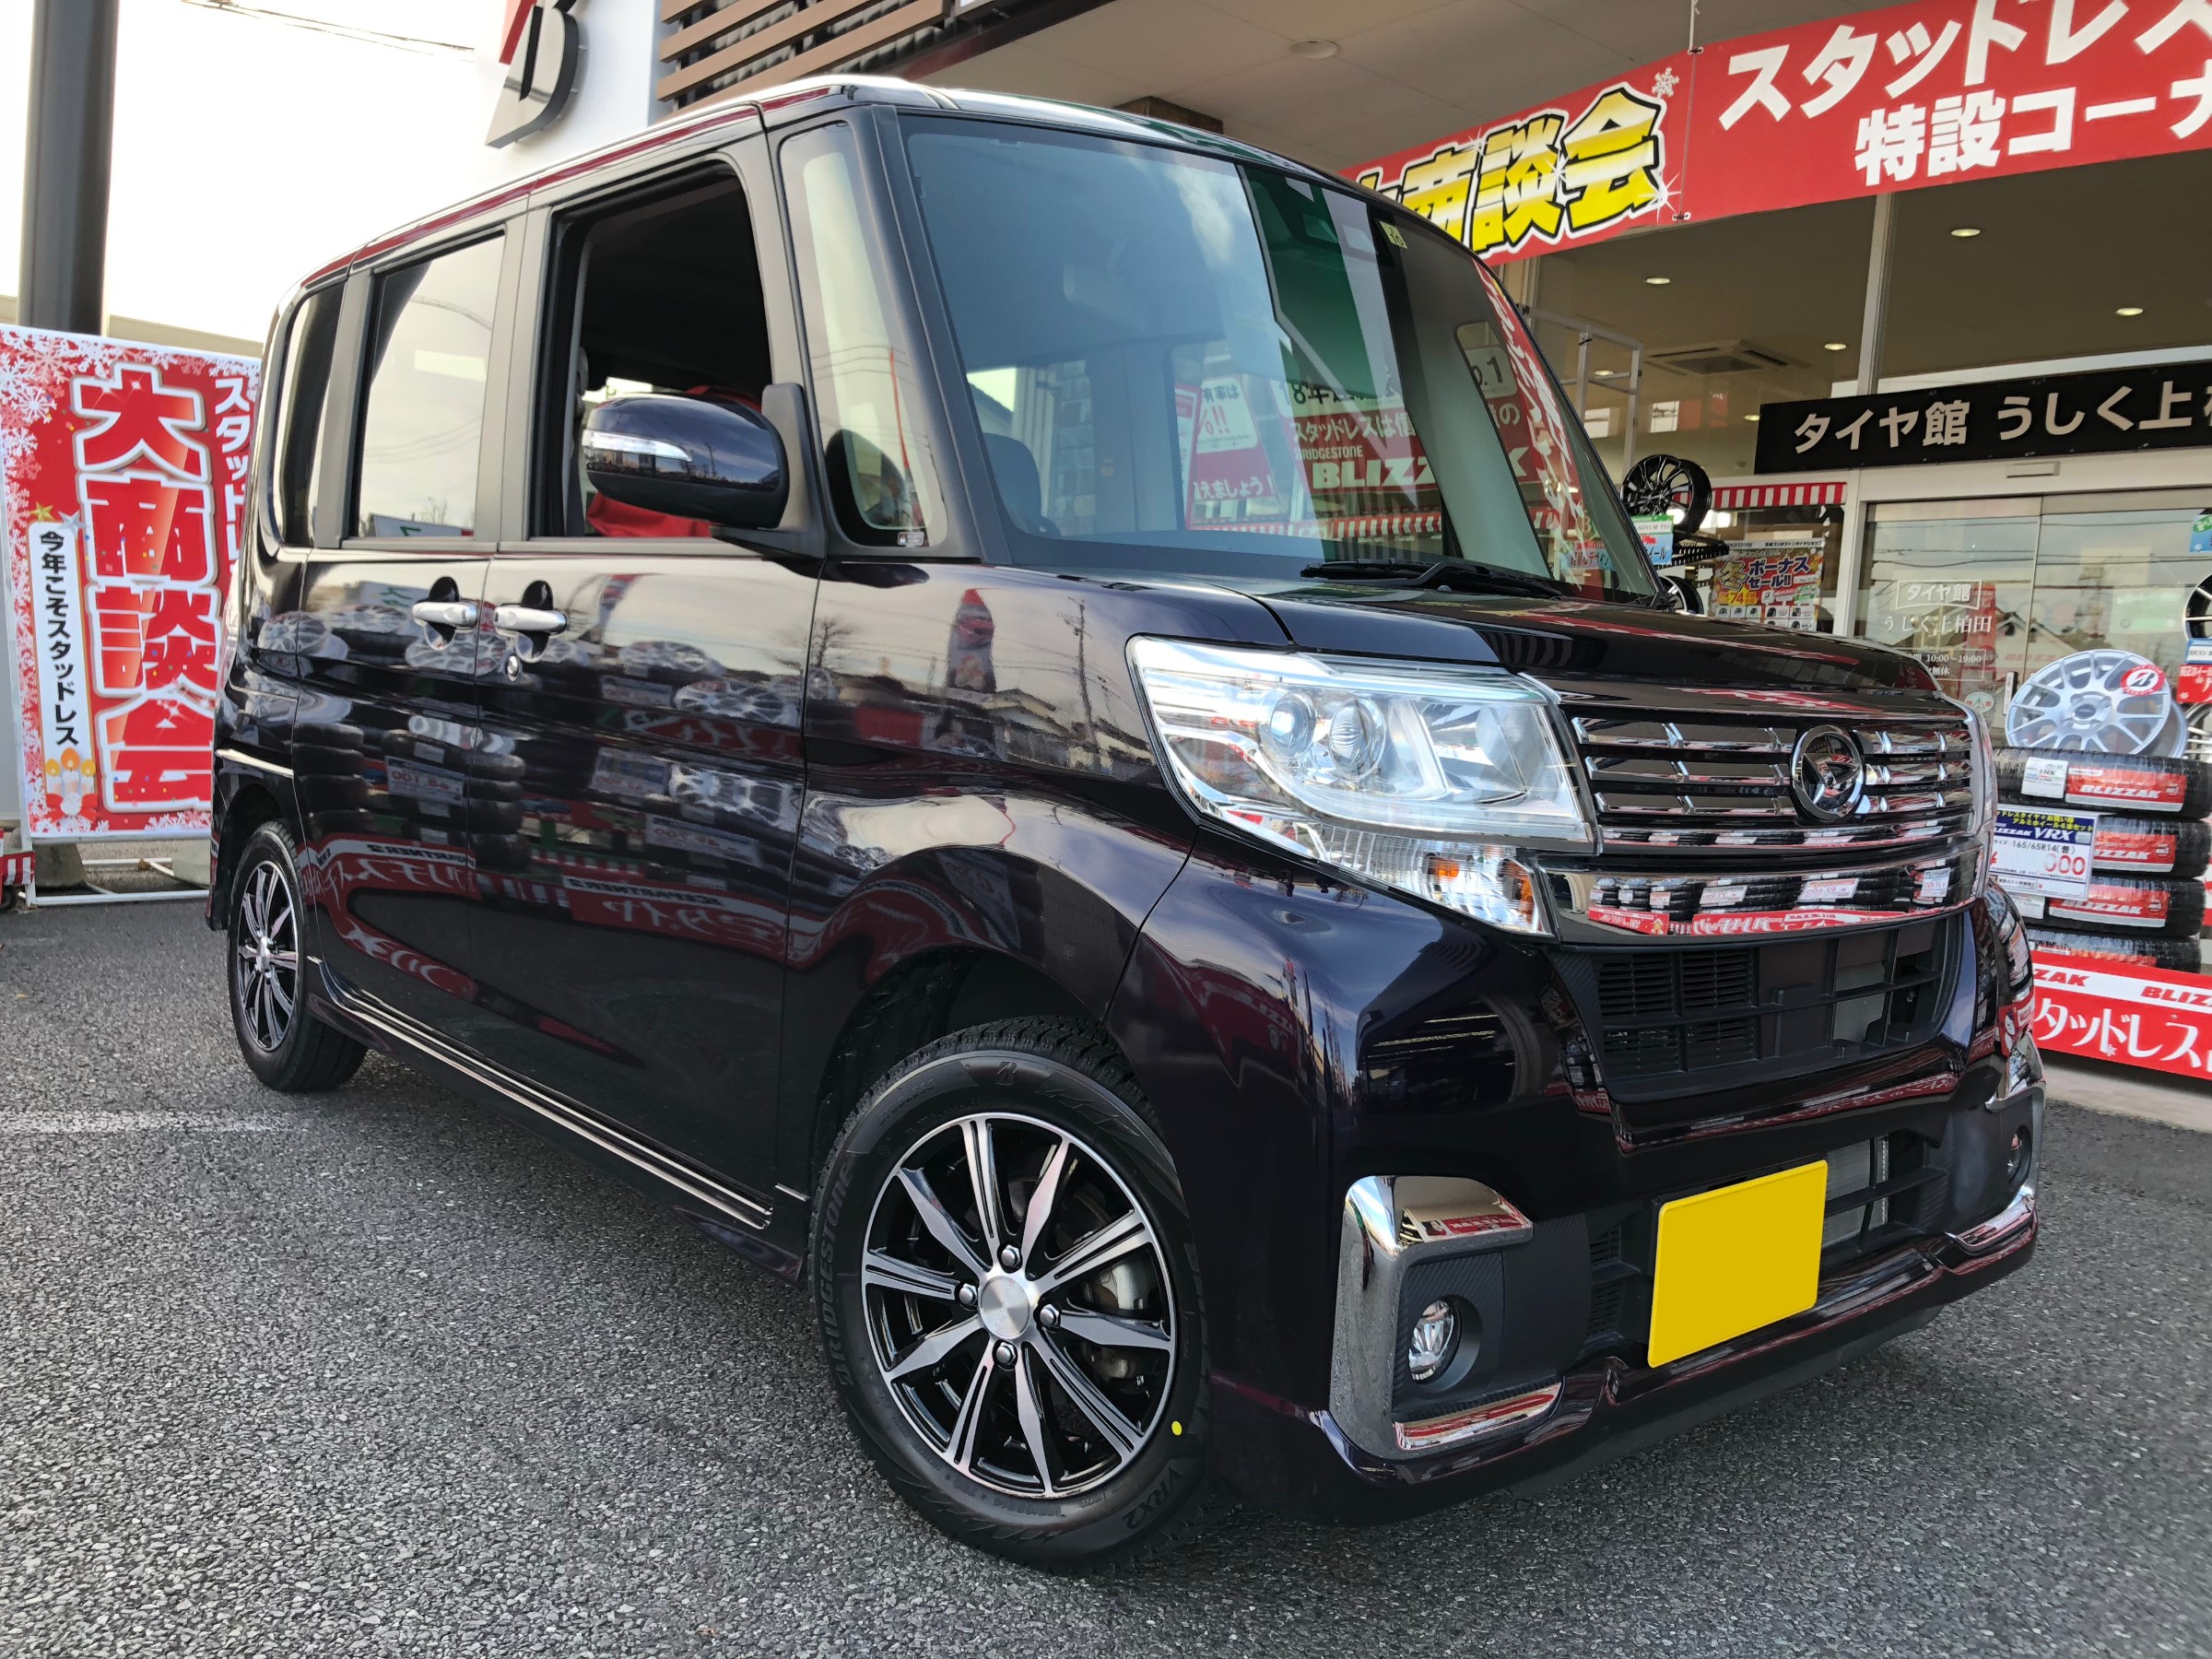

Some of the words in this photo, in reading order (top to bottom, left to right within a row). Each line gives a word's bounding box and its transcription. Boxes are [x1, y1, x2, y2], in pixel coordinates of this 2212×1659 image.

[1794, 400, 1970, 453] タイヤ館
[1997, 380, 2212, 441] うしく上
[215, 377, 251, 570] スタッドレ
[1721, 560, 1747, 590] 冬
[1748, 555, 1811, 575] ボーナス
[74, 365, 220, 811] 大商談会
[1730, 591, 1745, 605] 74
[1907, 583, 1971, 602] タイヤ館
[1885, 616, 1992, 634] うしく上柏田
[39, 529, 79, 747] 今年こそスタッドレス
[2079, 784, 2161, 799] BLIZZAK
[1994, 828, 2032, 837] LIZZAK
[2034, 827, 2075, 841] VRX
[2013, 818, 2093, 832] アルミホイール4本セット
[2094, 850, 2150, 860] IZZAK
[2141, 985, 2212, 1007] BLIZ
[819, 1163, 855, 1387] BRIDGESTONE
[1121, 1466, 1183, 1529] VRX2
